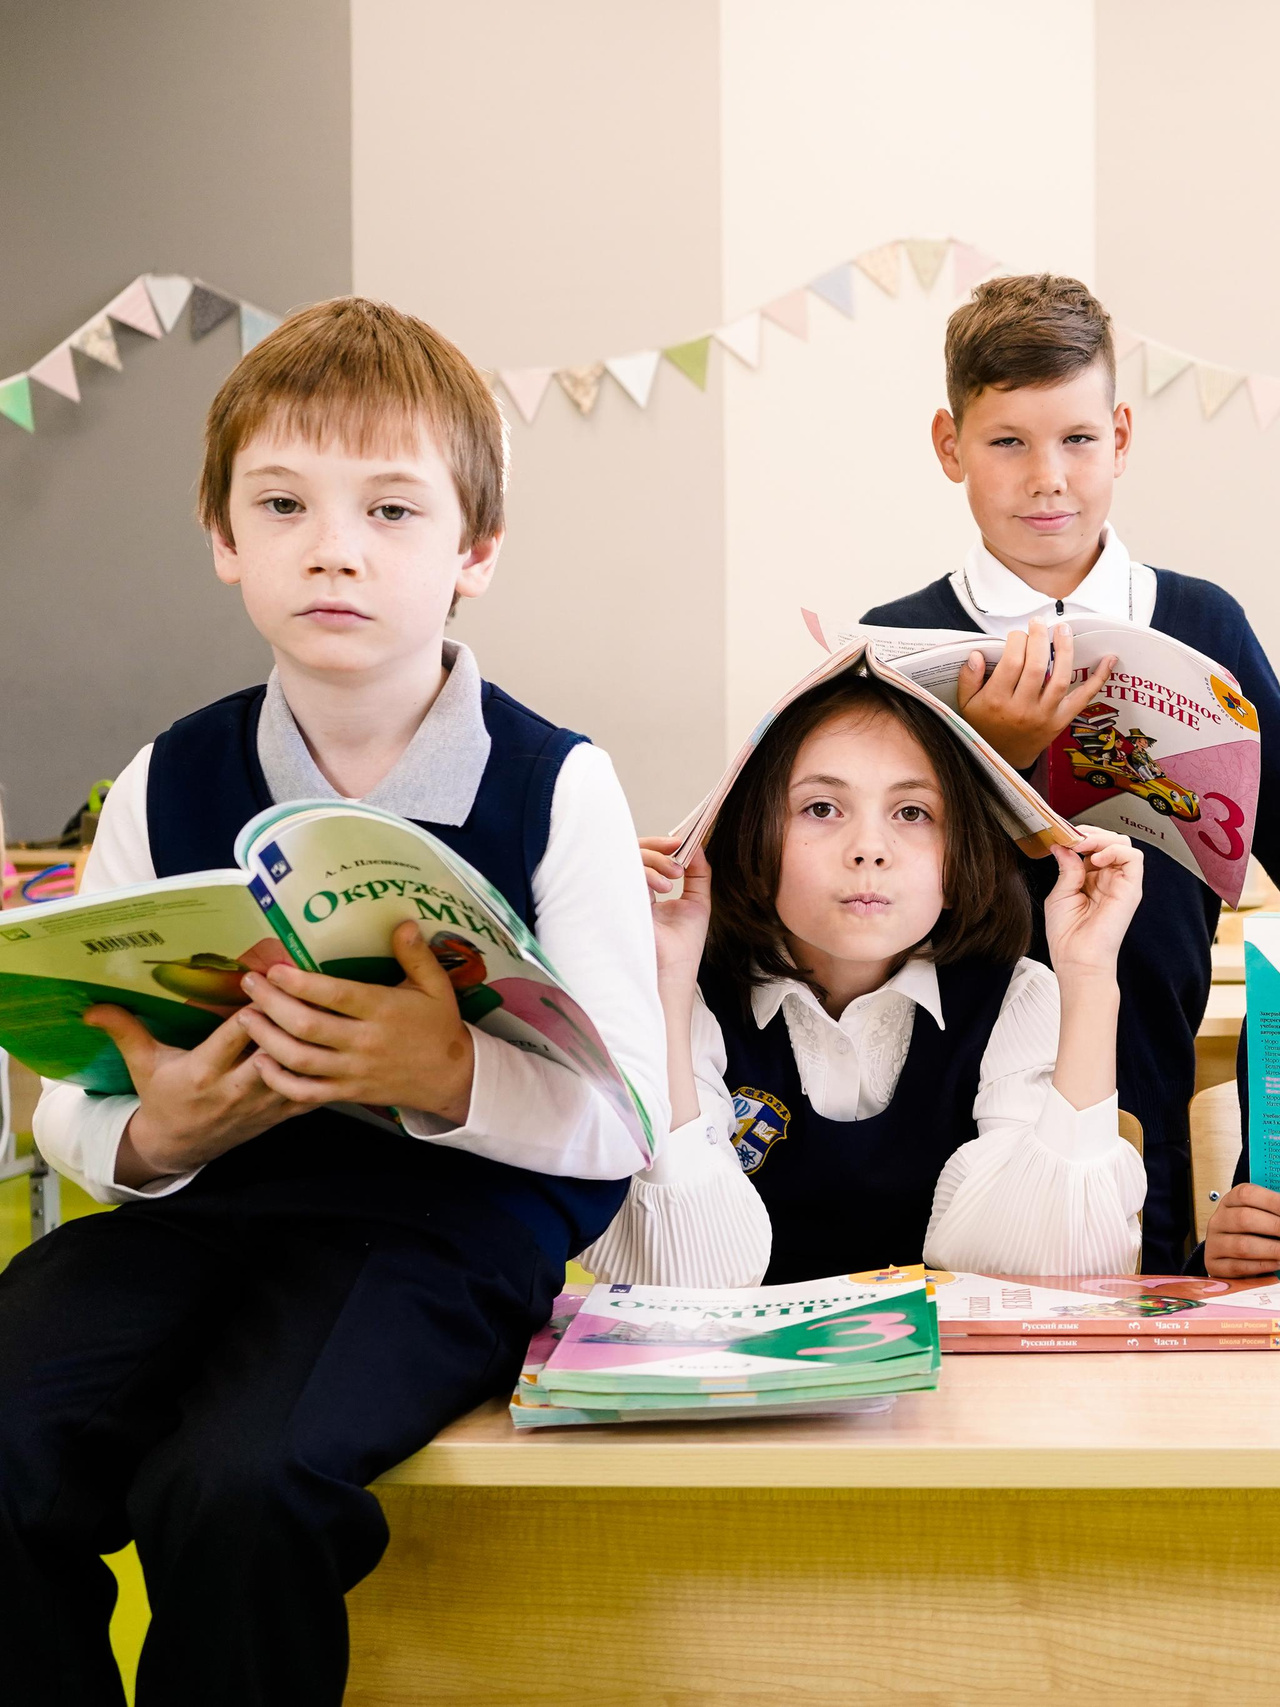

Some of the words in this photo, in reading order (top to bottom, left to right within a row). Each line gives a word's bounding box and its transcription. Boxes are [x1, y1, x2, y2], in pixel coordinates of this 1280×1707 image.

[1119, 814, 1156, 836] Часть
[1159, 830, 1167, 841] 1
[1197, 791, 1246, 861] 3
[745, 1088, 789, 1117] ШКОЛА
[732, 1117, 757, 1147] 1
[702, 1302, 833, 1319] МИР
[796, 1312, 917, 1357] 3
[1022, 1322, 1056, 1332] Русский
[1057, 1322, 1079, 1331] язык
[1128, 1321, 1141, 1330] 3
[1155, 1321, 1180, 1330] Часть
[1183, 1321, 1190, 1330] 2
[1020, 1339, 1055, 1348] Русский
[1056, 1339, 1078, 1348] язык
[1127, 1338, 1140, 1347] 3
[1153, 1338, 1179, 1347] Часть
[1182, 1338, 1188, 1346] 1
